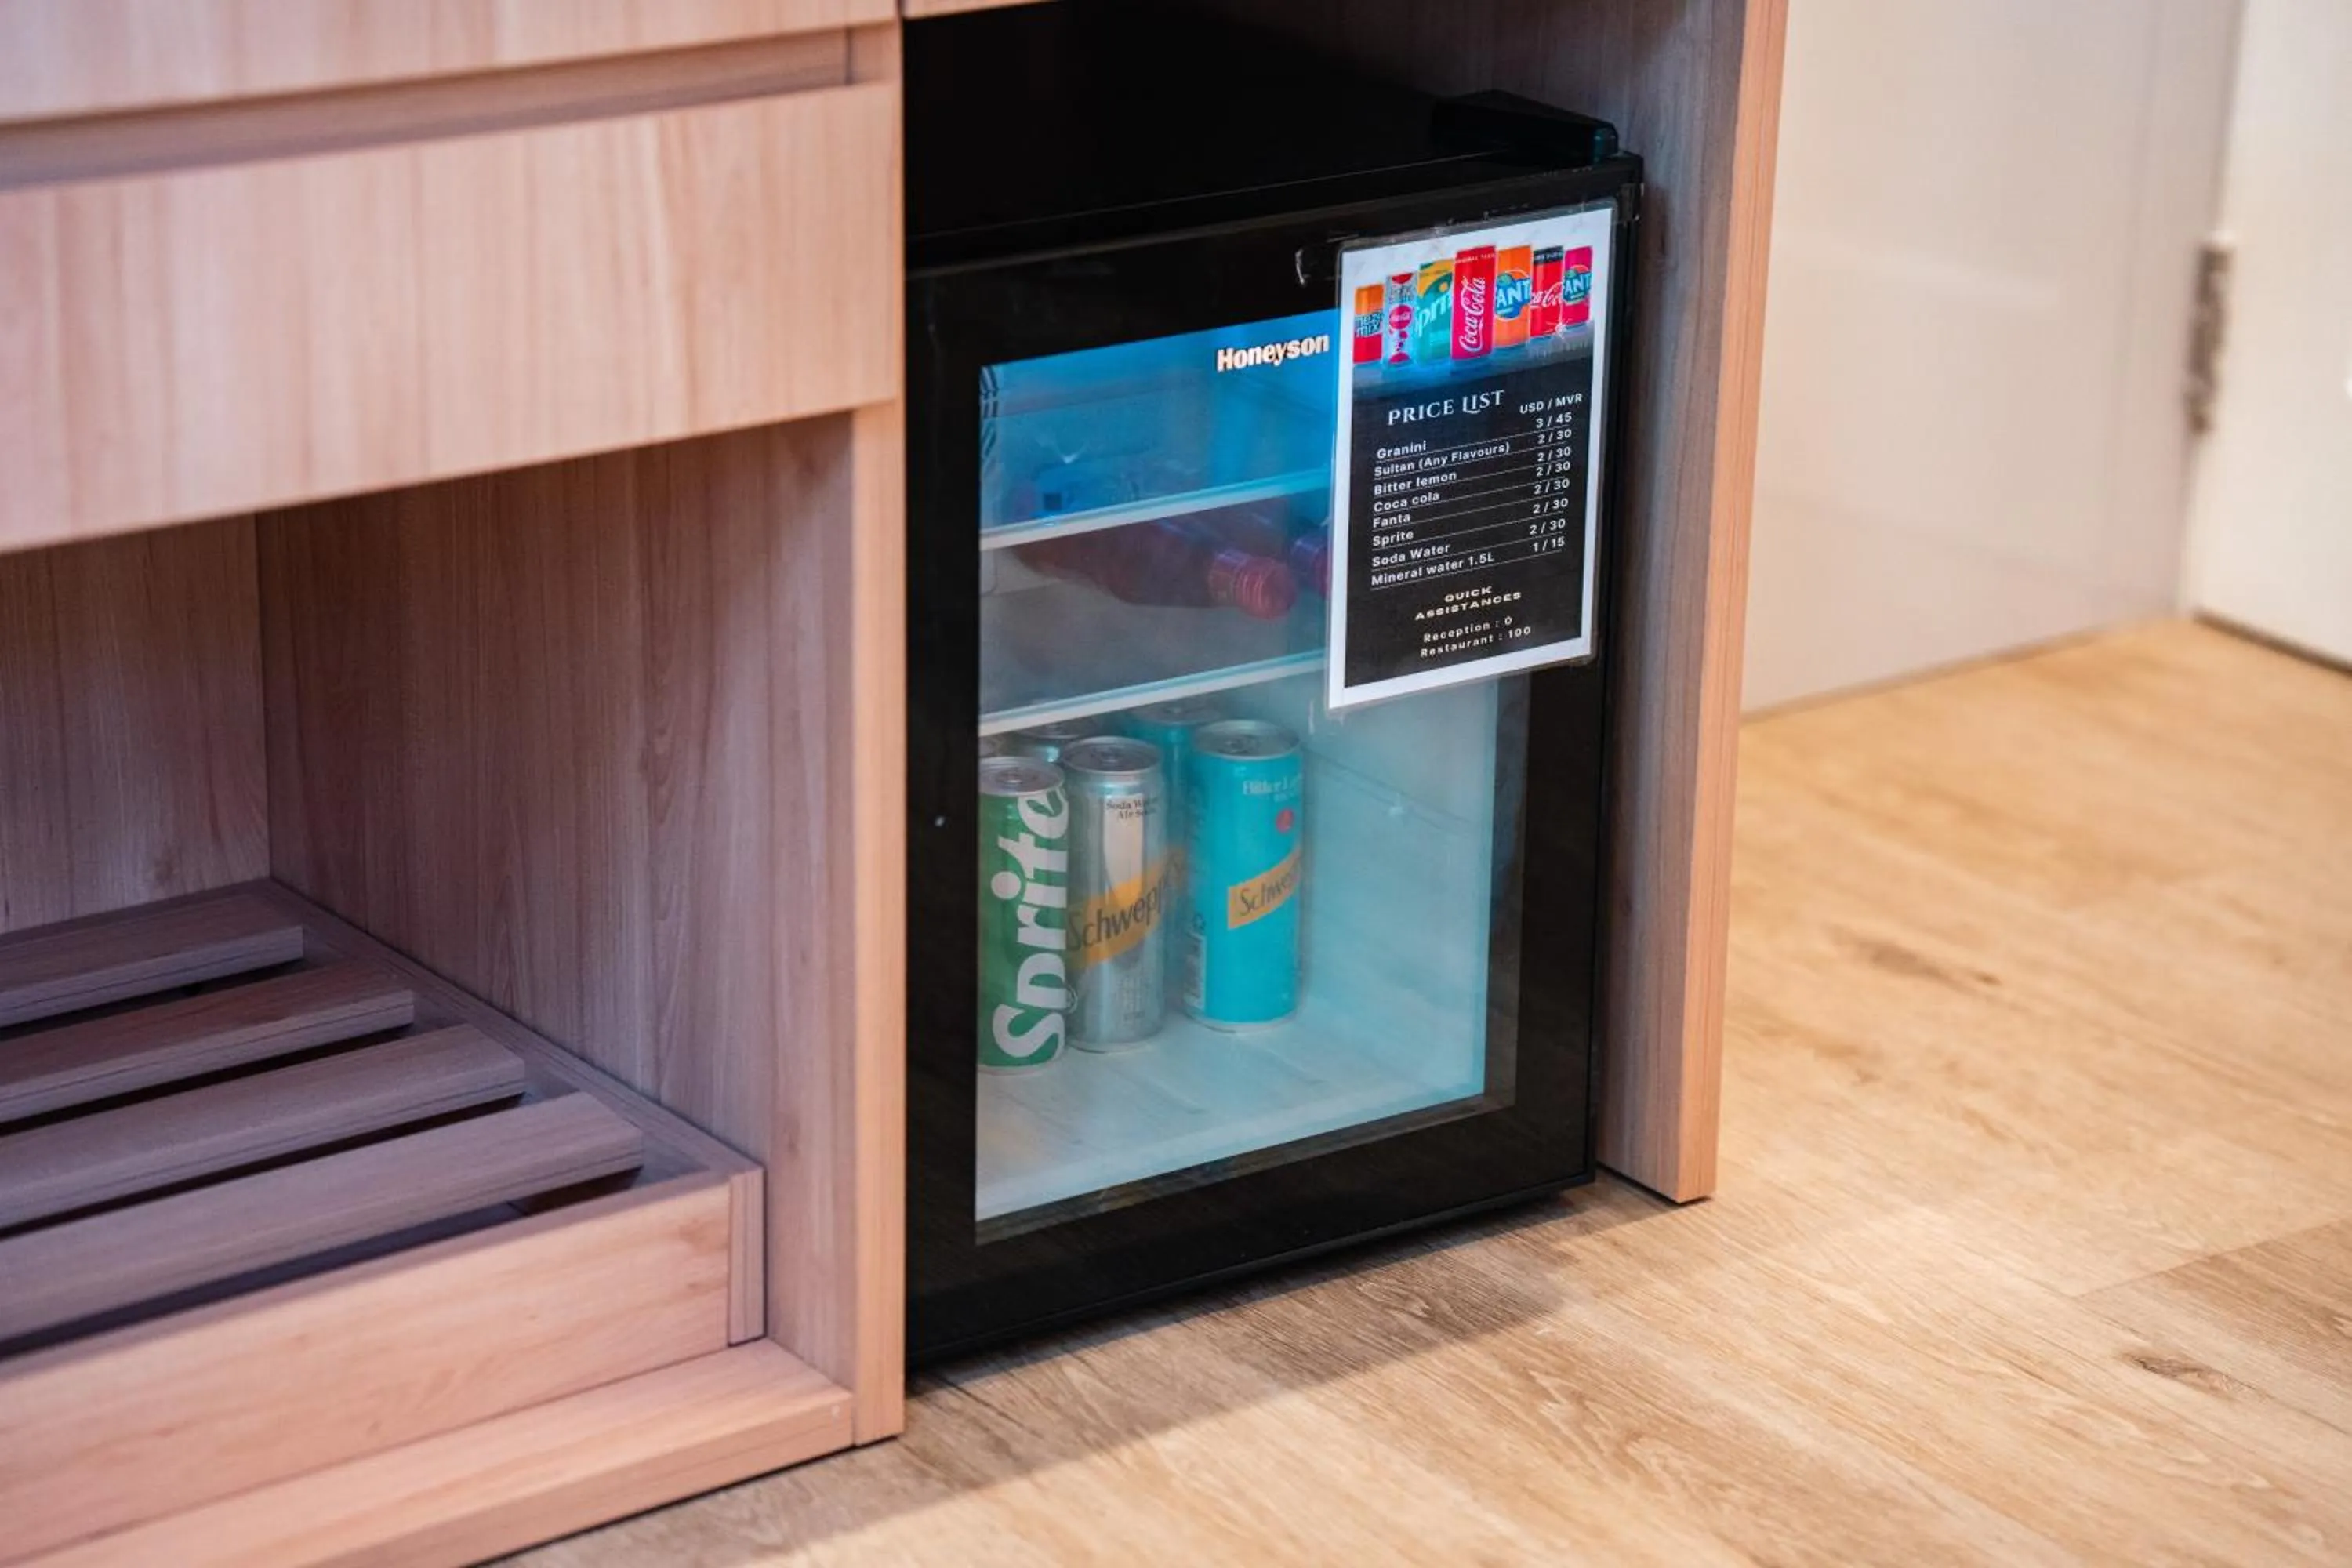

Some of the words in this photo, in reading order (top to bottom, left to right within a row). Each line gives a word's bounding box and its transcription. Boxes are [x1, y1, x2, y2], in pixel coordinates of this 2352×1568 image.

[1496, 280, 1531, 308] ANT
[1564, 273, 1591, 296] ANT
[1217, 334, 1330, 372] Honeyson
[1388, 399, 1454, 426] PRICE
[1462, 390, 1504, 414] LIST
[1519, 401, 1544, 414] USD
[1555, 393, 1582, 406] MVR
[1536, 418, 1544, 428] 3
[1555, 412, 1572, 423] 45
[1537, 434, 1544, 444] 2
[1556, 429, 1572, 439] 30
[1377, 440, 1427, 459] Granini
[1537, 452, 1544, 462] 2
[1555, 446, 1571, 458] 30
[1374, 462, 1414, 477] Sultan
[1418, 455, 1448, 470] (Any
[1451, 442, 1510, 462] Flavours)
[1536, 466, 1544, 477] 2
[1555, 461, 1570, 473] 30
[1374, 480, 1412, 495] Bitter
[1416, 472, 1457, 487] lemon
[1534, 485, 1541, 495] 2
[1554, 477, 1570, 490] 30
[1374, 499, 1408, 512] Coca
[1412, 492, 1440, 505] cola
[1533, 504, 1541, 514] 2
[1552, 498, 1568, 509] 30
[1373, 514, 1410, 528] Fanta
[1530, 524, 1537, 535] 2
[1550, 518, 1566, 531] 30
[1373, 531, 1414, 547] Sprite
[1533, 542, 1538, 552] 1
[1552, 535, 1565, 548] 15
[1373, 553, 1406, 567] Soda
[1410, 544, 1450, 559] Water
[1371, 567, 1423, 586] Mineral
[1426, 559, 1465, 575] water
[1468, 552, 1495, 567] 1.5L
[1445, 586, 1492, 602] QUICK
[1414, 592, 1522, 620] ASSISTANCES
[1423, 622, 1490, 643] Reception
[1504, 616, 1512, 626] 0
[1508, 626, 1531, 638] 100
[991, 786, 1069, 1058] Sprite
